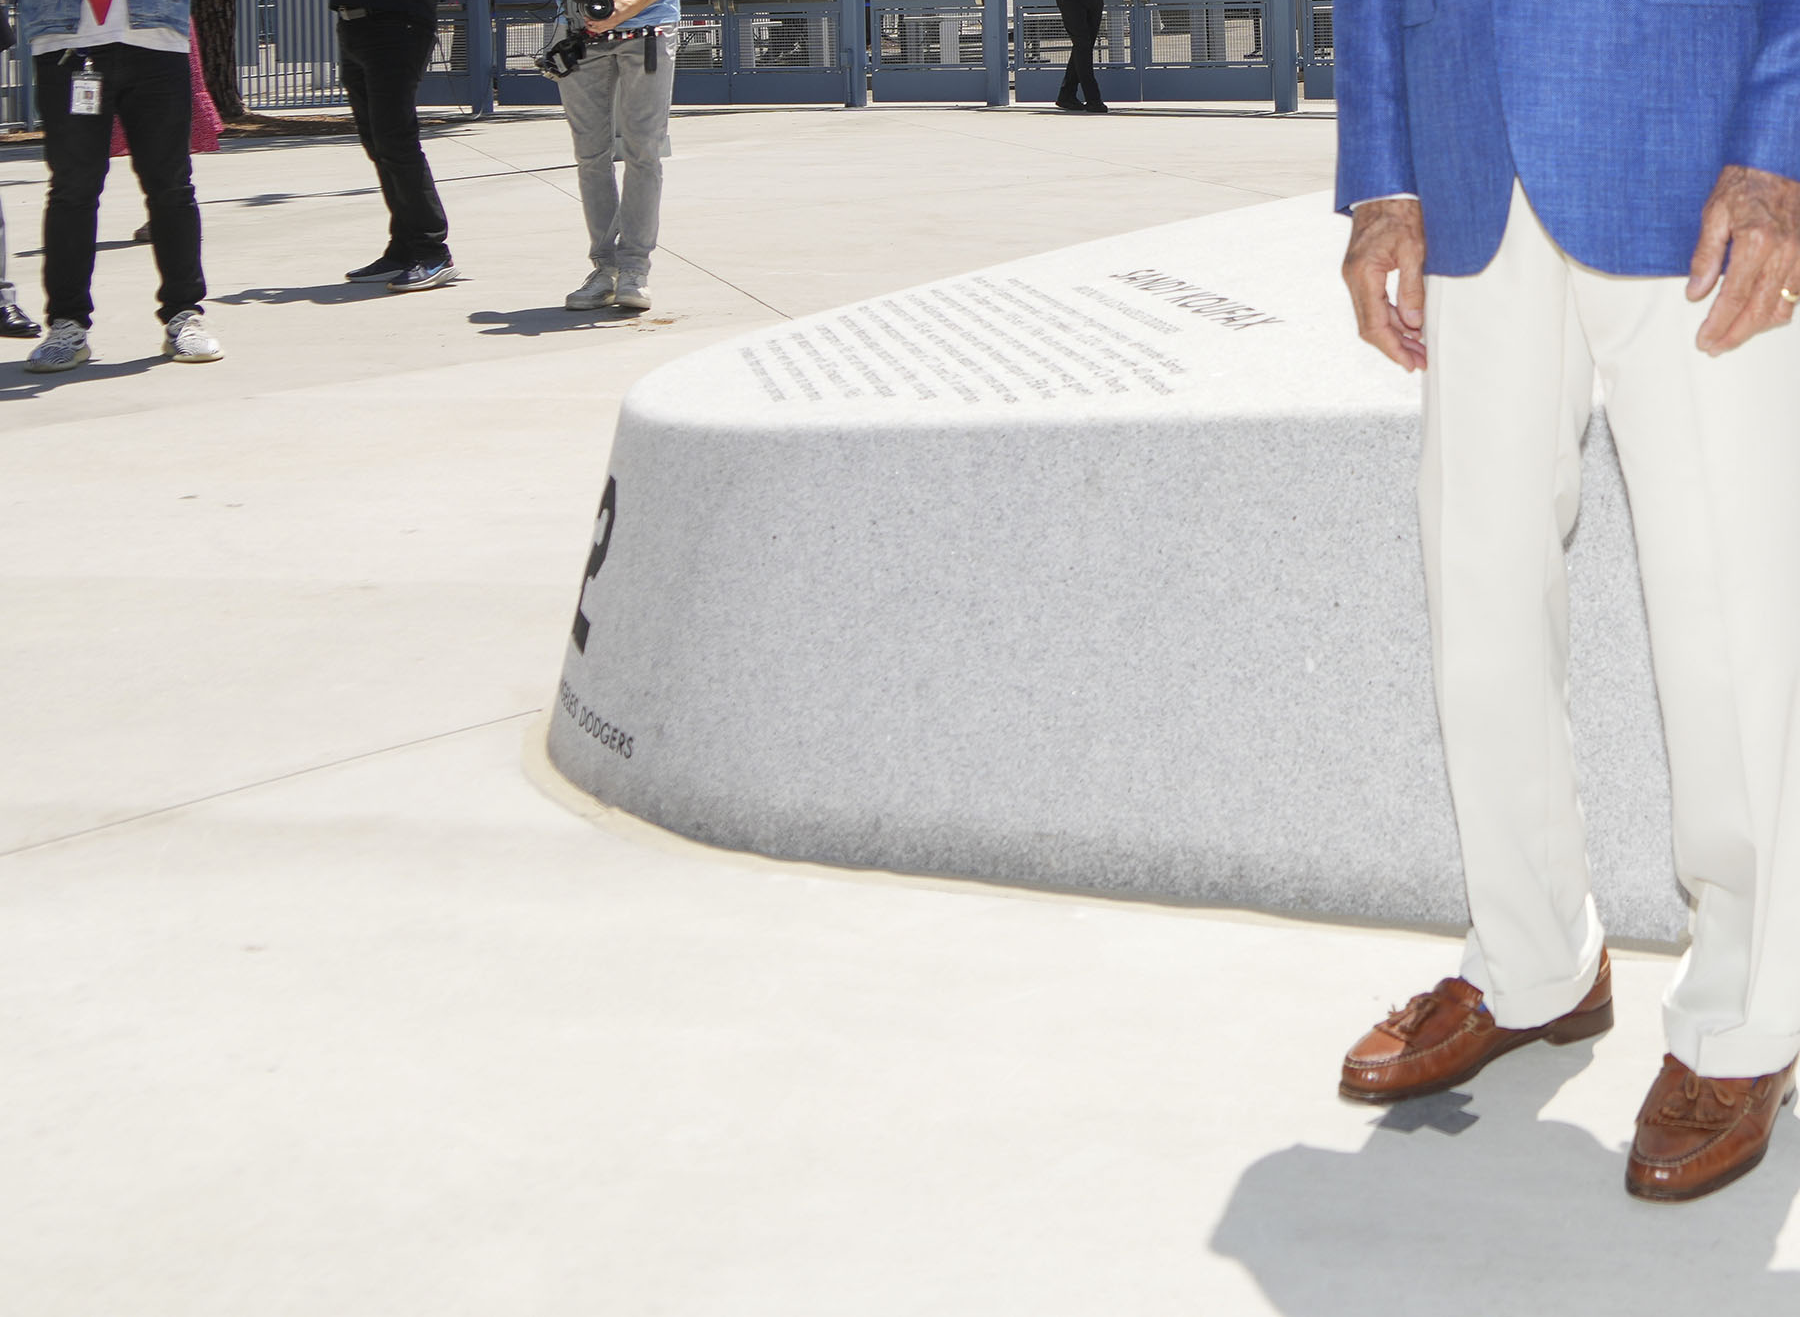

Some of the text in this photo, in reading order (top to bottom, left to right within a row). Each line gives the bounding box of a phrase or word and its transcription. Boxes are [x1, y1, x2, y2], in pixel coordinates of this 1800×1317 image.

[1108, 269, 1202, 296] SANDY
[1163, 291, 1287, 331] KOUFAX
[578, 705, 635, 760] DODGERS
